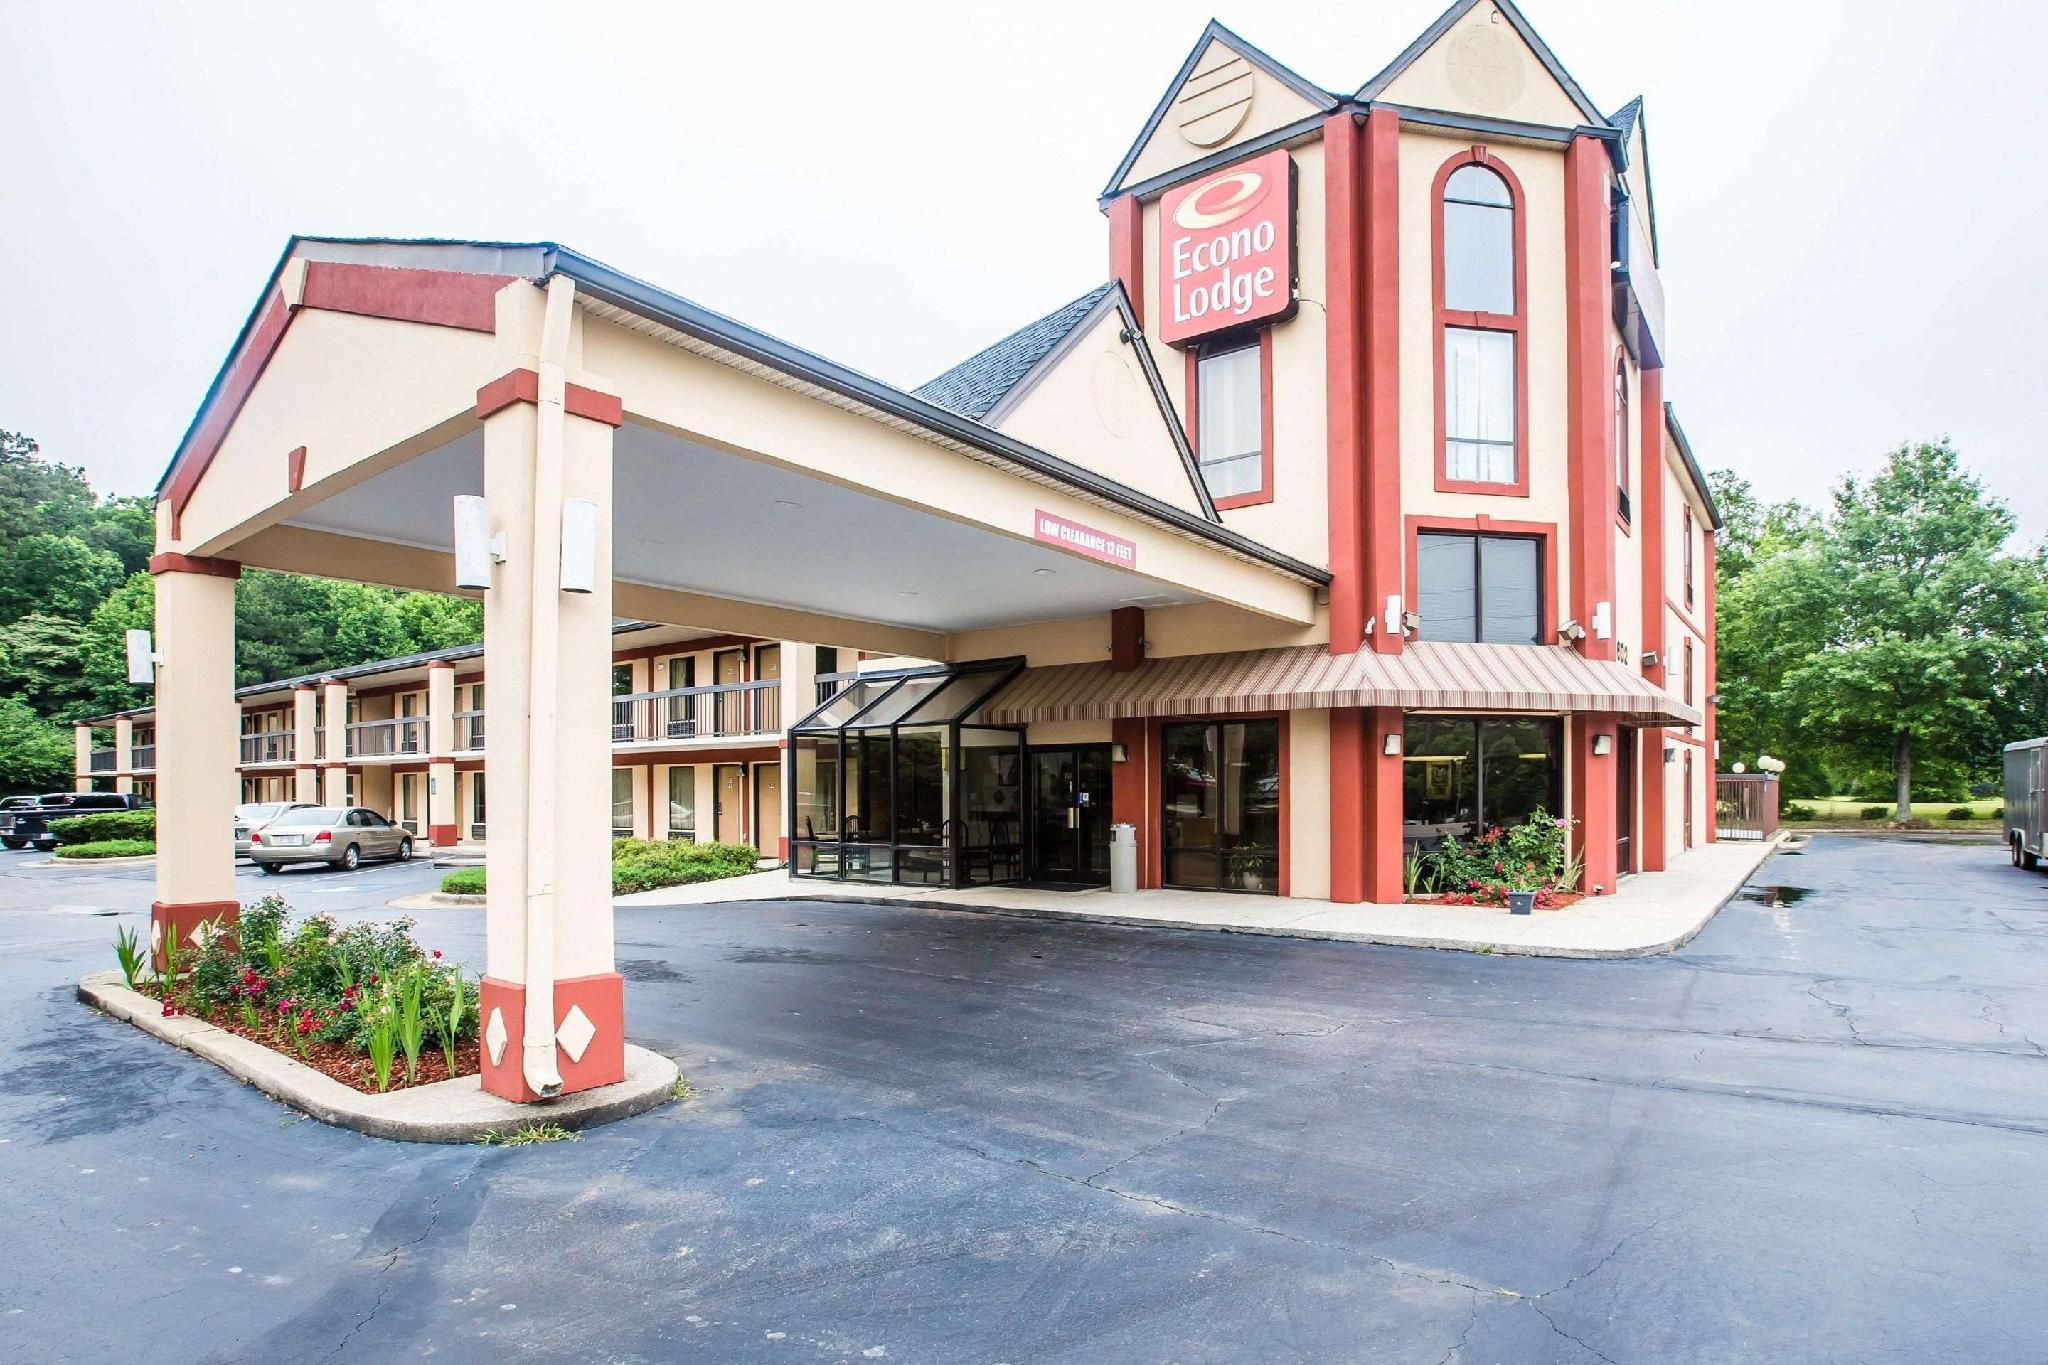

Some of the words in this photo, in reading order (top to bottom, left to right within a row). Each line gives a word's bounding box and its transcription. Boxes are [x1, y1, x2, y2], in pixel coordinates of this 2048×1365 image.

[1173, 220, 1275, 280] Econo
[1174, 266, 1275, 323] Lodge
[1040, 518, 1060, 538] LOW
[1060, 525, 1105, 553] CLEARANCE
[1106, 541, 1115, 556] 12
[1116, 543, 1132, 561] FEET
